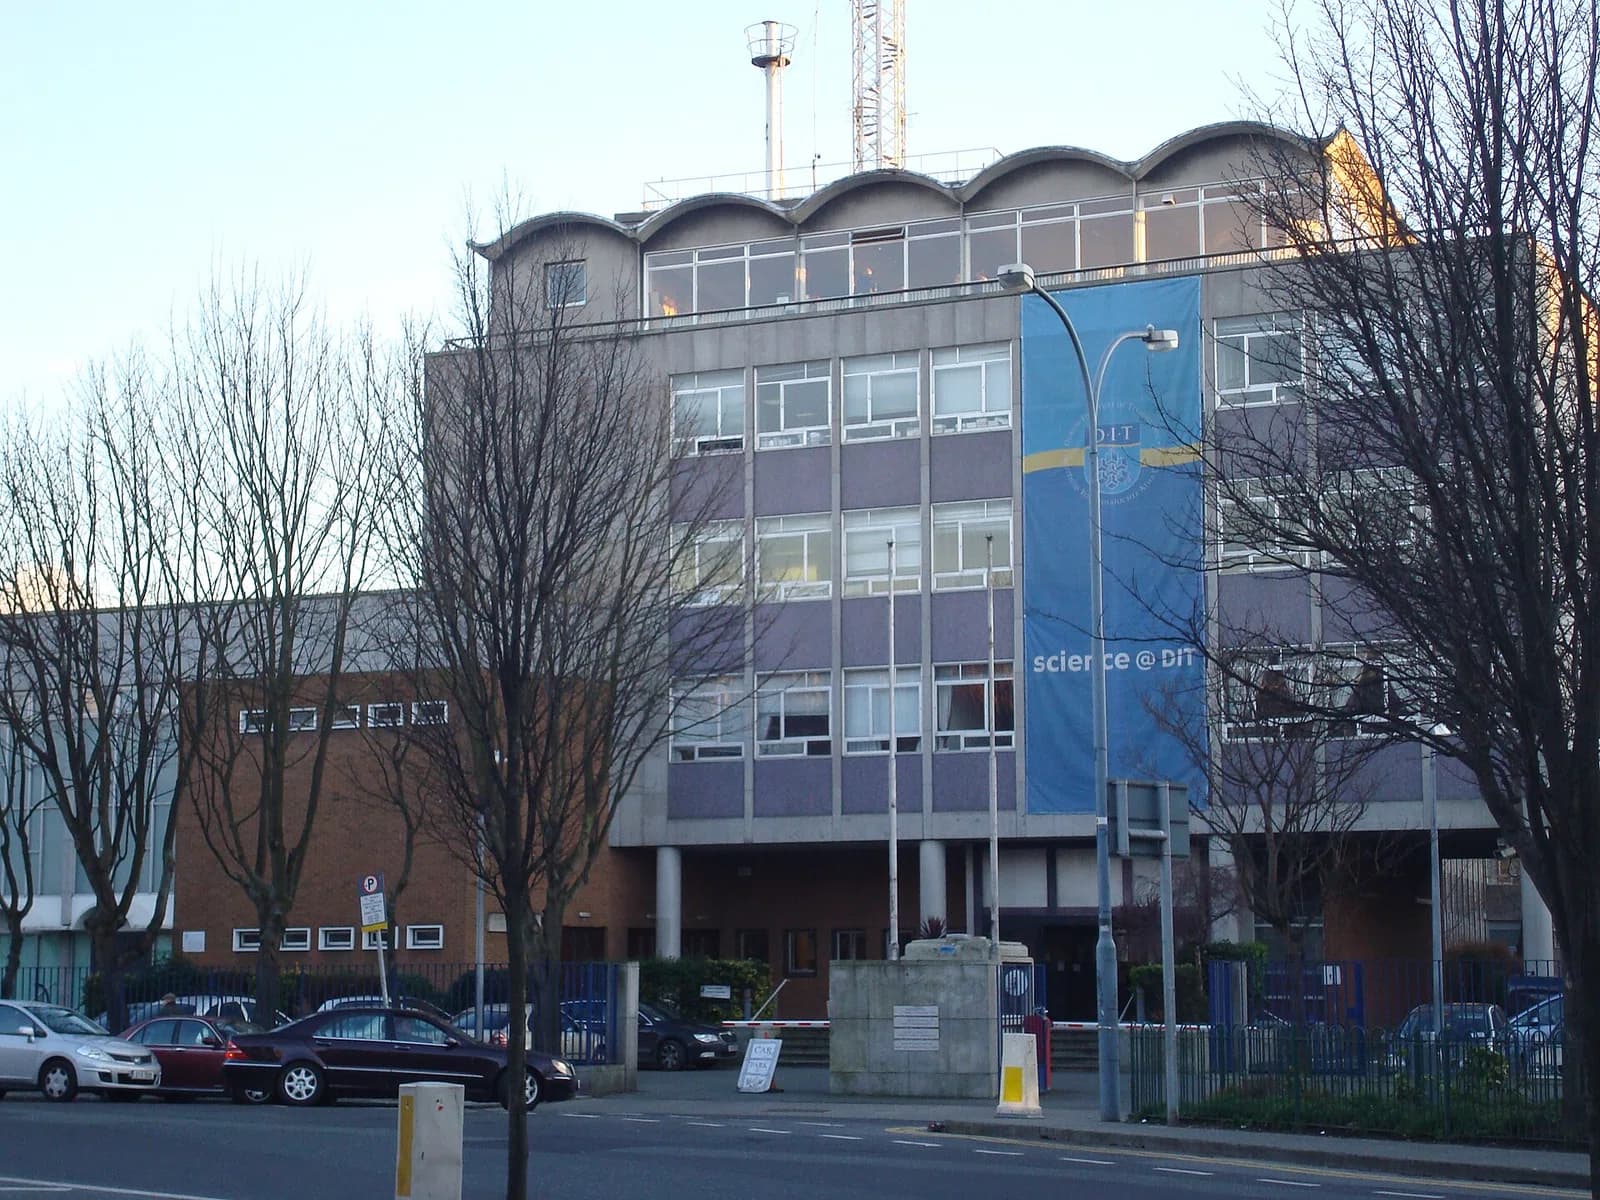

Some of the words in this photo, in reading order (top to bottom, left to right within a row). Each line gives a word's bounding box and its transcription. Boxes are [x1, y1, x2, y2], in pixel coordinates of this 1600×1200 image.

[1136, 650, 1156, 671] @
[1161, 648, 1197, 668] DIT
[367, 878, 375, 890] P
[754, 1046, 773, 1055] CAR
